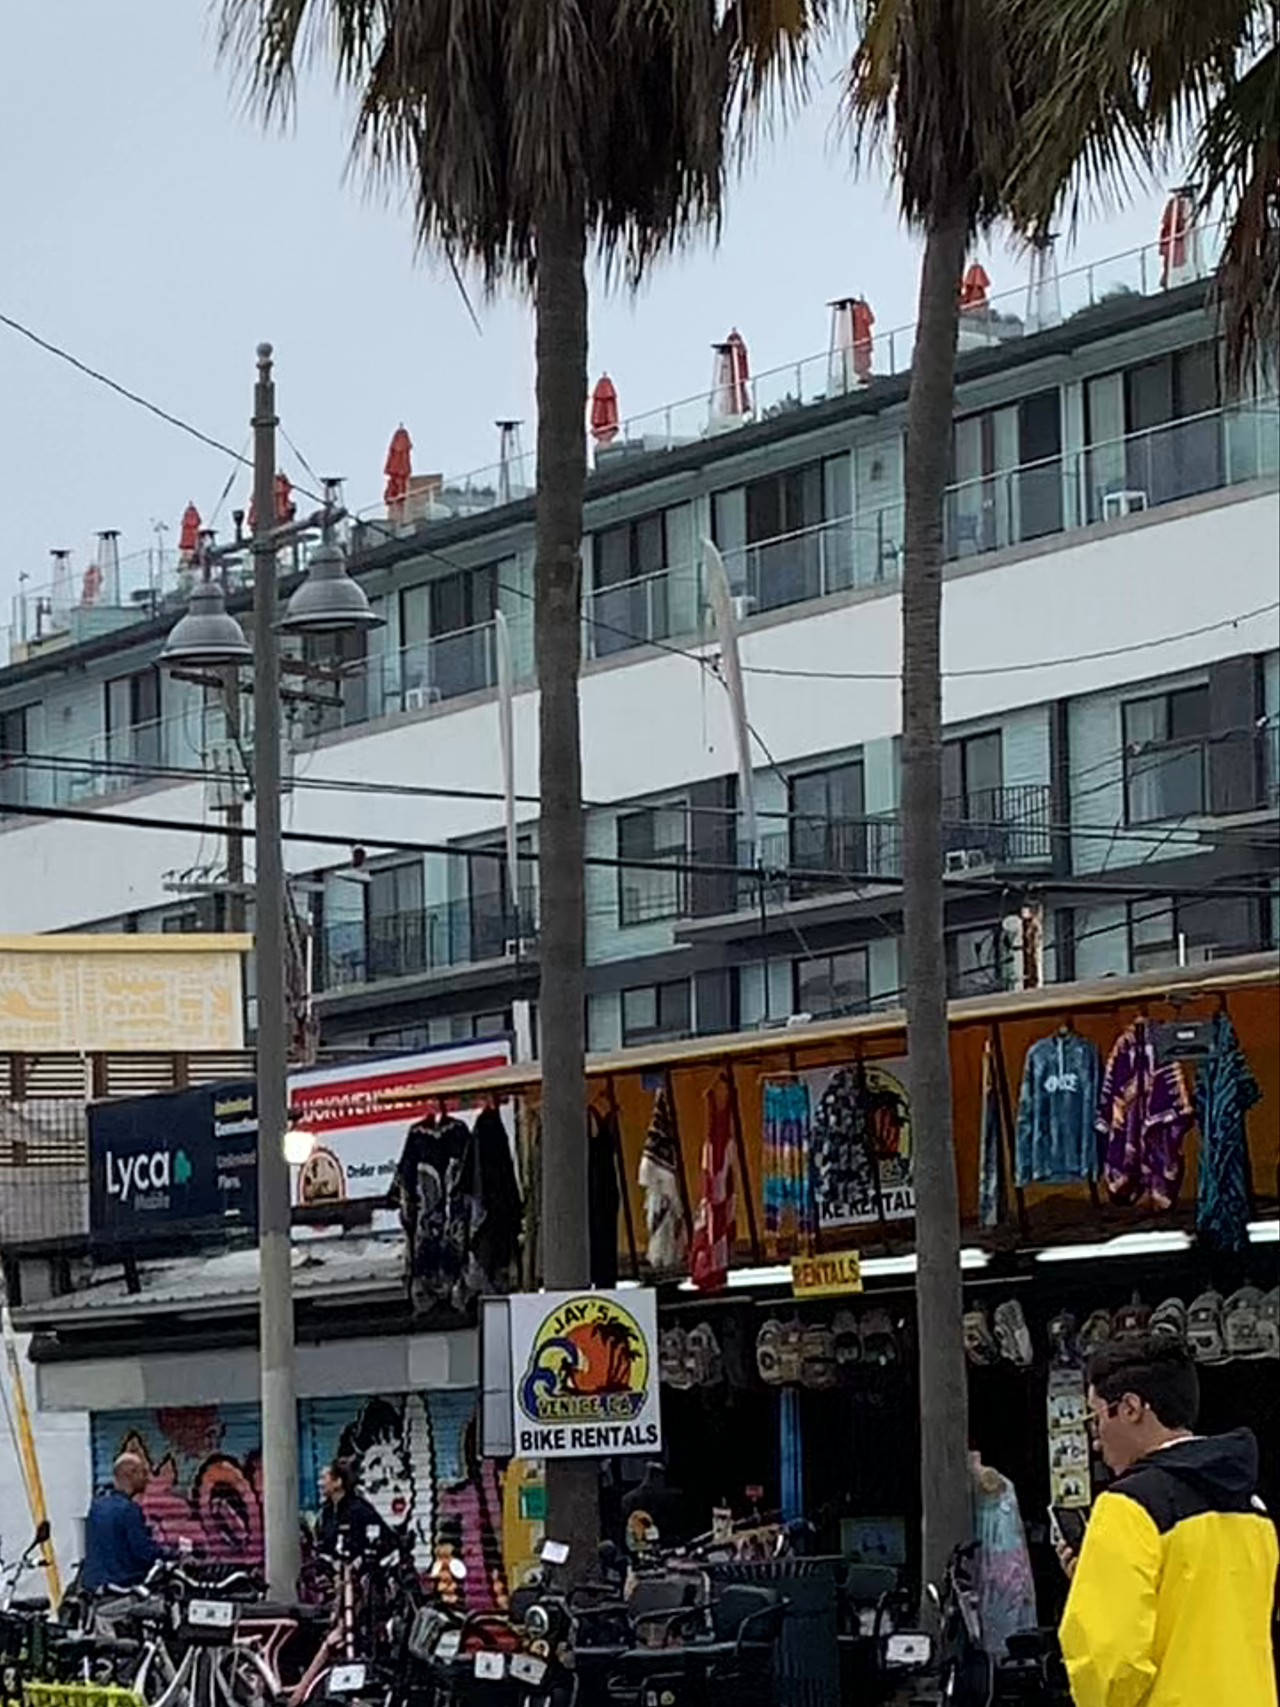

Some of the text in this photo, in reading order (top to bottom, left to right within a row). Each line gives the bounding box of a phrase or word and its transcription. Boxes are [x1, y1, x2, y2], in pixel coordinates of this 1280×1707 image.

[106, 1151, 170, 1201] Lyca
[792, 1259, 859, 1287] RENTALS
[554, 1302, 610, 1335] JAY'S
[521, 1424, 658, 1451] BIKE RENTALS
